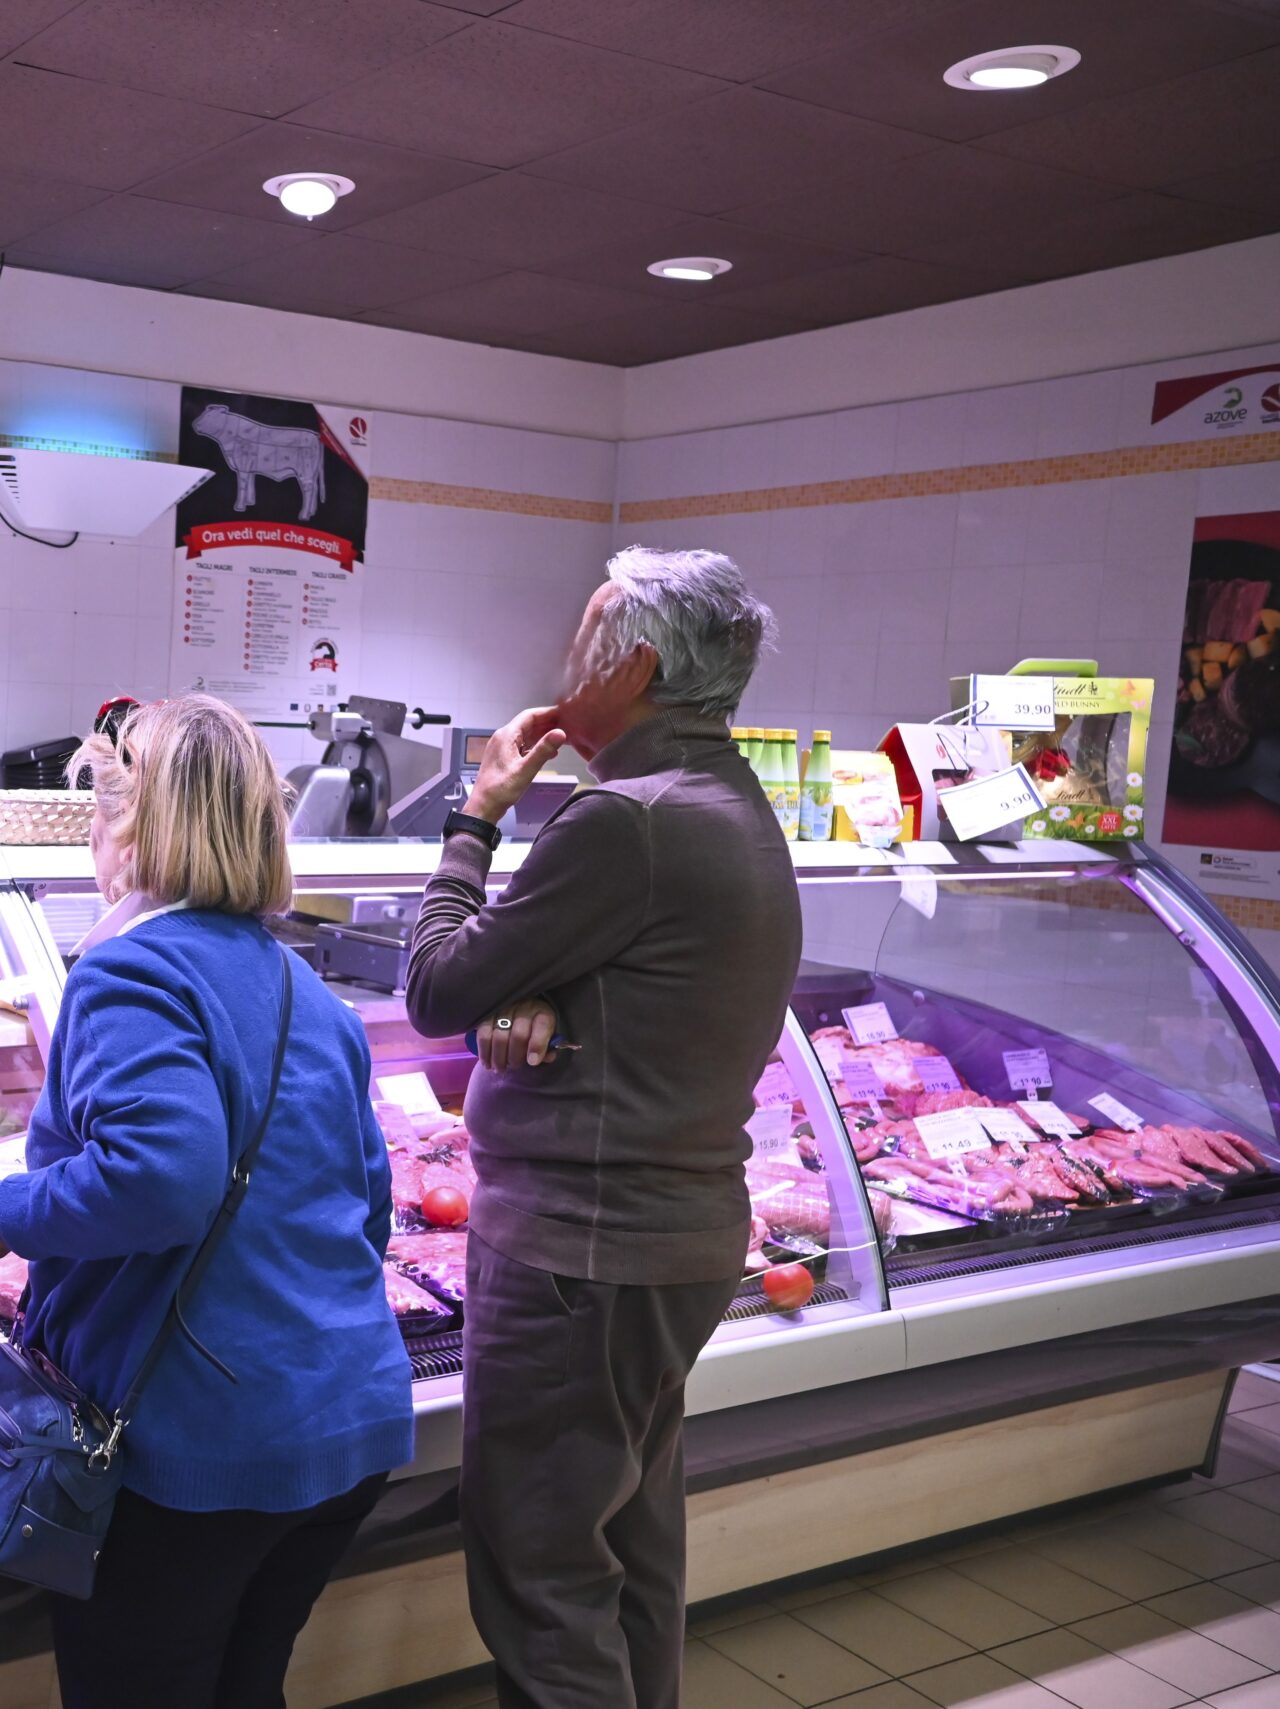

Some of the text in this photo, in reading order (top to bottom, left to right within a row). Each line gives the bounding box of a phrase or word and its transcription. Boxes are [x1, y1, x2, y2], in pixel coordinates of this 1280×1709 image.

[1203, 408, 1248, 424] azove
[202, 528, 342, 555] Ora vedi quel che scegli.
[1070, 700, 1100, 708] BUNNY
[1103, 815, 1117, 824] XXL
